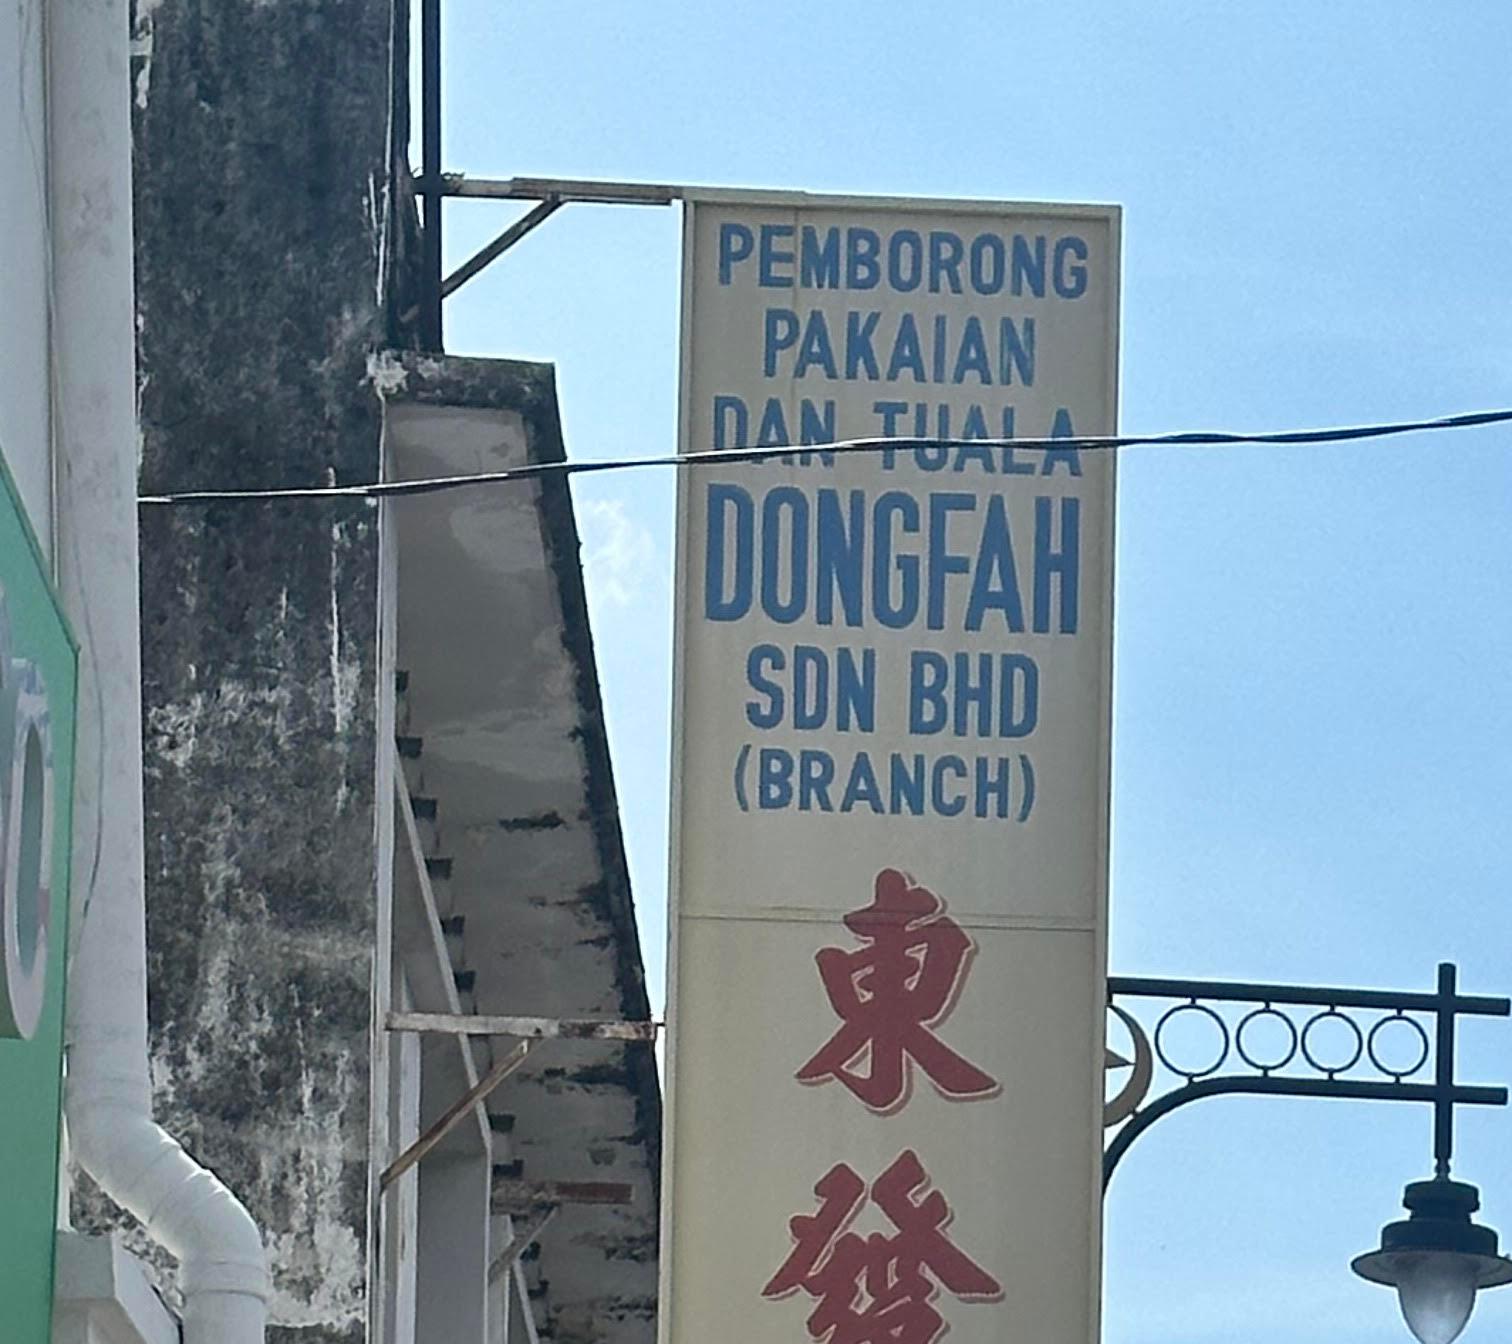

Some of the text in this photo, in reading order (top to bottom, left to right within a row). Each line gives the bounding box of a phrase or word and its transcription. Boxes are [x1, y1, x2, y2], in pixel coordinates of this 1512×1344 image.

[718, 223, 1088, 299] PEMBORONG
[763, 308, 1035, 387] PAKAIAN
[711, 394, 1083, 477] DAN TUALA
[704, 482, 1081, 636] DONGFAH
[746, 643, 1040, 739] SDN BHD
[734, 744, 1036, 824] (BRANCH)
